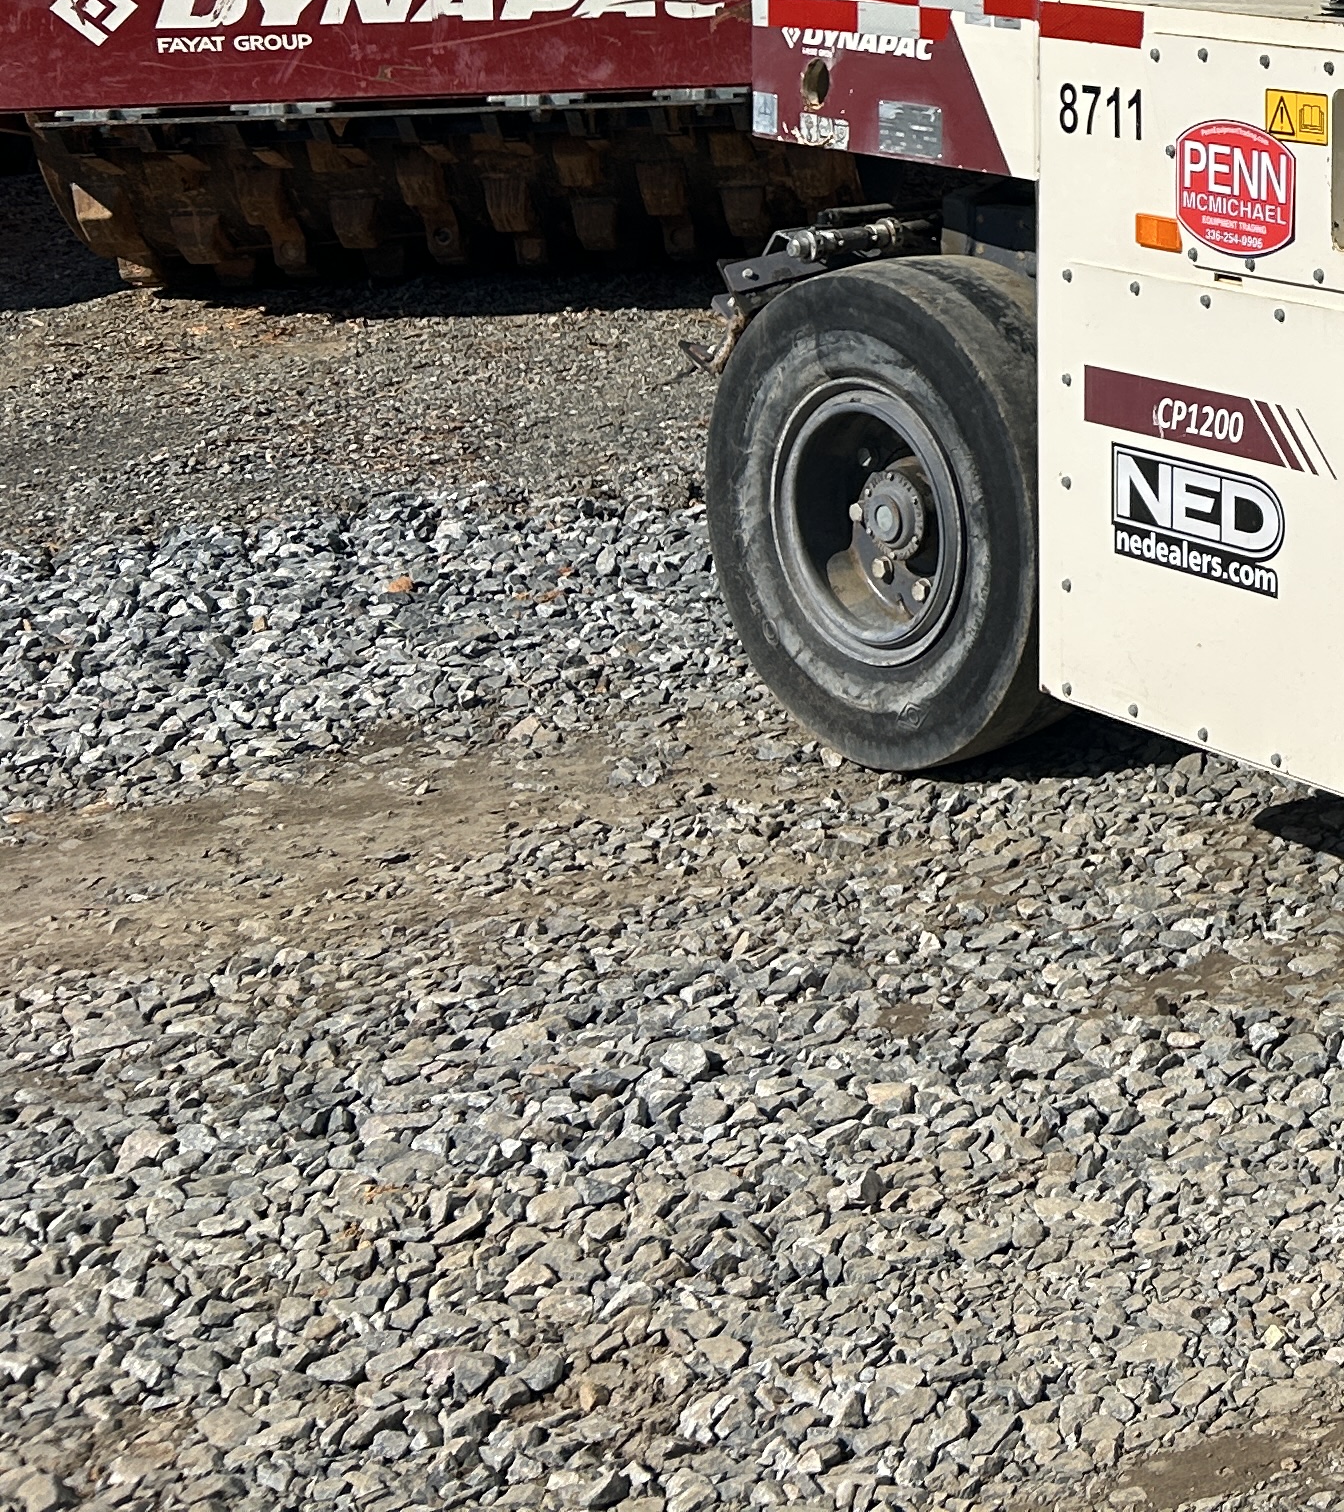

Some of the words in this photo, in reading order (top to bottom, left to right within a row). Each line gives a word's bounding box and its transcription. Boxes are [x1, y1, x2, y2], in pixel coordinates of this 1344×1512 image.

[157, 36, 225, 54] FAYAT
[233, 34, 313, 51] GROUP
[802, 28, 934, 61] DYNAPAC
[1059, 82, 1142, 141] 8711
[1183, 140, 1288, 204] PENN
[1182, 190, 1287, 226] MCMICHAEL
[1201, 215, 1238, 230] EQUIPMENT
[1157, 397, 1245, 444] CP1200
[1117, 453, 1280, 551] NED
[1115, 528, 1277, 593] nedealers.com
